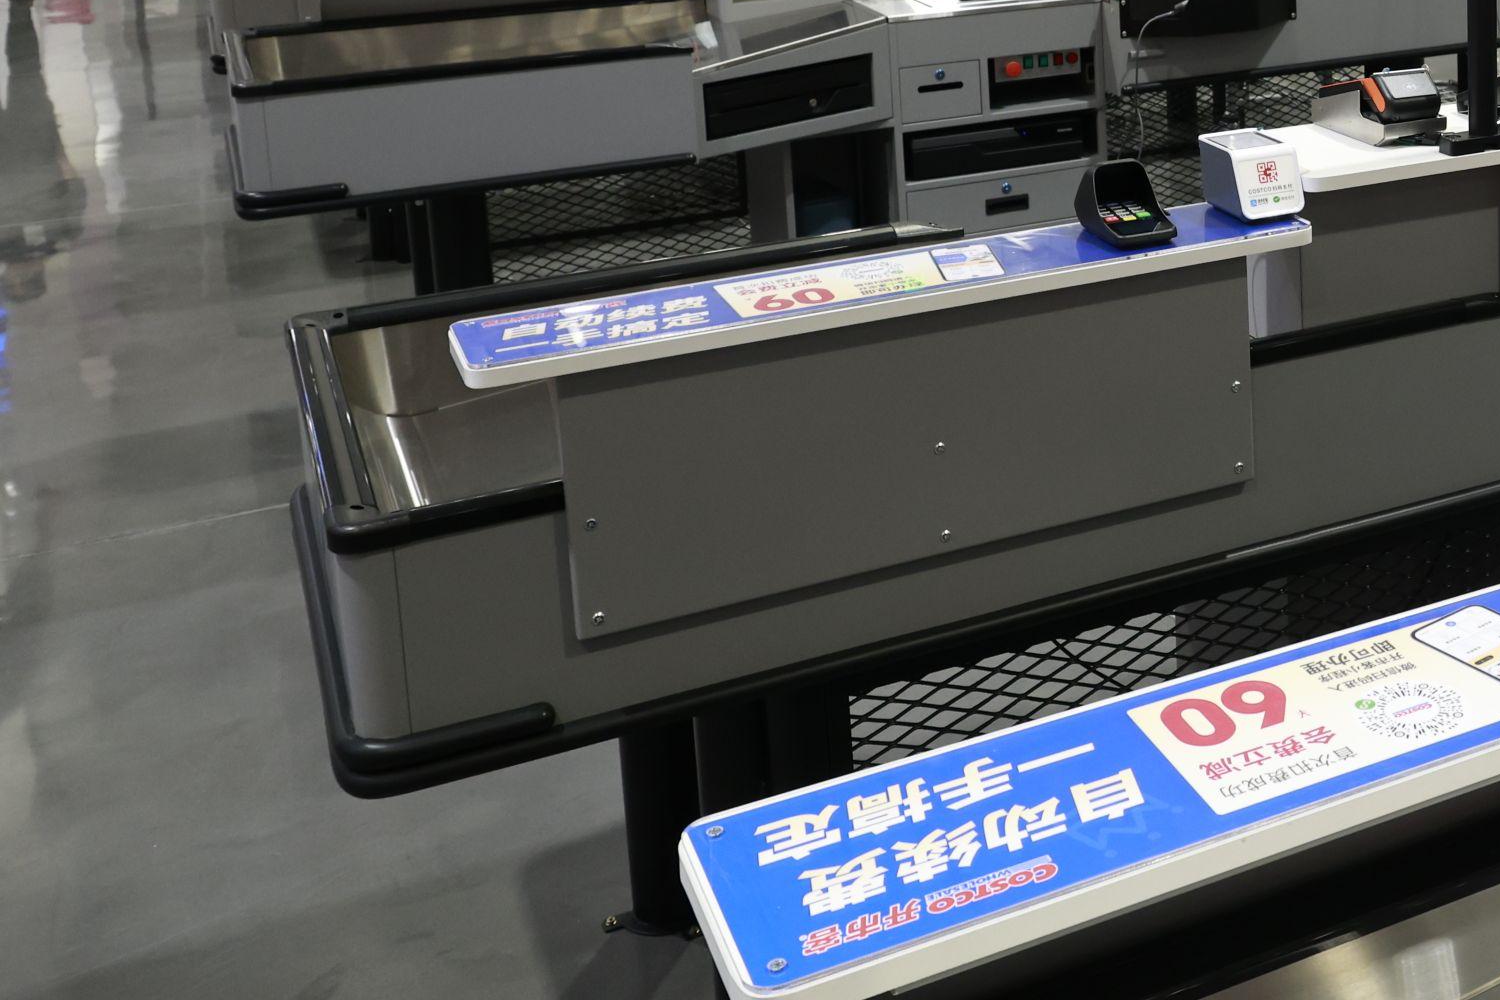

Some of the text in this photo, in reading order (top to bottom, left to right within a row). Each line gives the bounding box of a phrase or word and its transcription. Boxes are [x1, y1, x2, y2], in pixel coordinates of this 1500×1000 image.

[1300, 639, 1397, 675] 即可办理
[1317, 651, 1405, 682] 开市客小程序
[1327, 662, 1418, 692] 微信扫码进入
[1199, 726, 1337, 782] 会费立减
[1218, 745, 1358, 799] 首次扣费成功
[754, 742, 1095, 867] 一手搞定
[798, 767, 1145, 917] 自动续费
[801, 862, 1059, 957] COSTCO 开市客
[925, 868, 1013, 902] WHOLESALE
